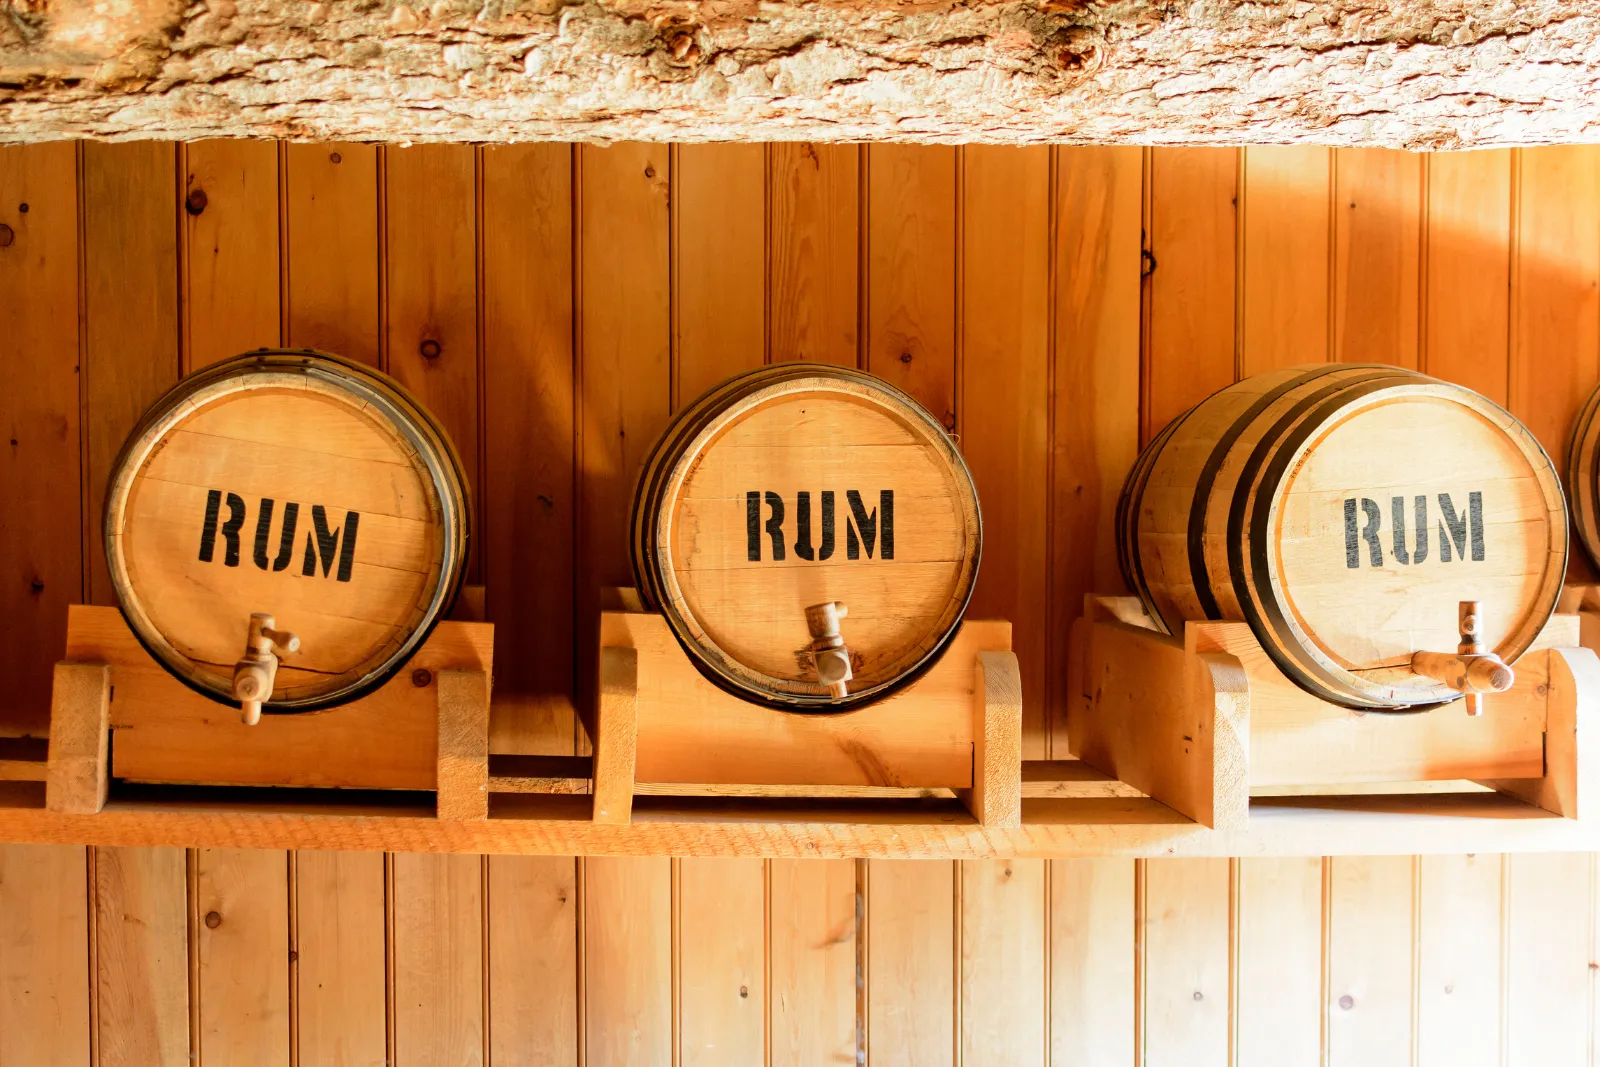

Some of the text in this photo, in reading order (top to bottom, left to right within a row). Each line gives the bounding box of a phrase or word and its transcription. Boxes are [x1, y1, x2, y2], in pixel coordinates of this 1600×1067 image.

[199, 490, 360, 583] RUM
[747, 490, 895, 562] RUM
[1343, 491, 1485, 569] RUM
